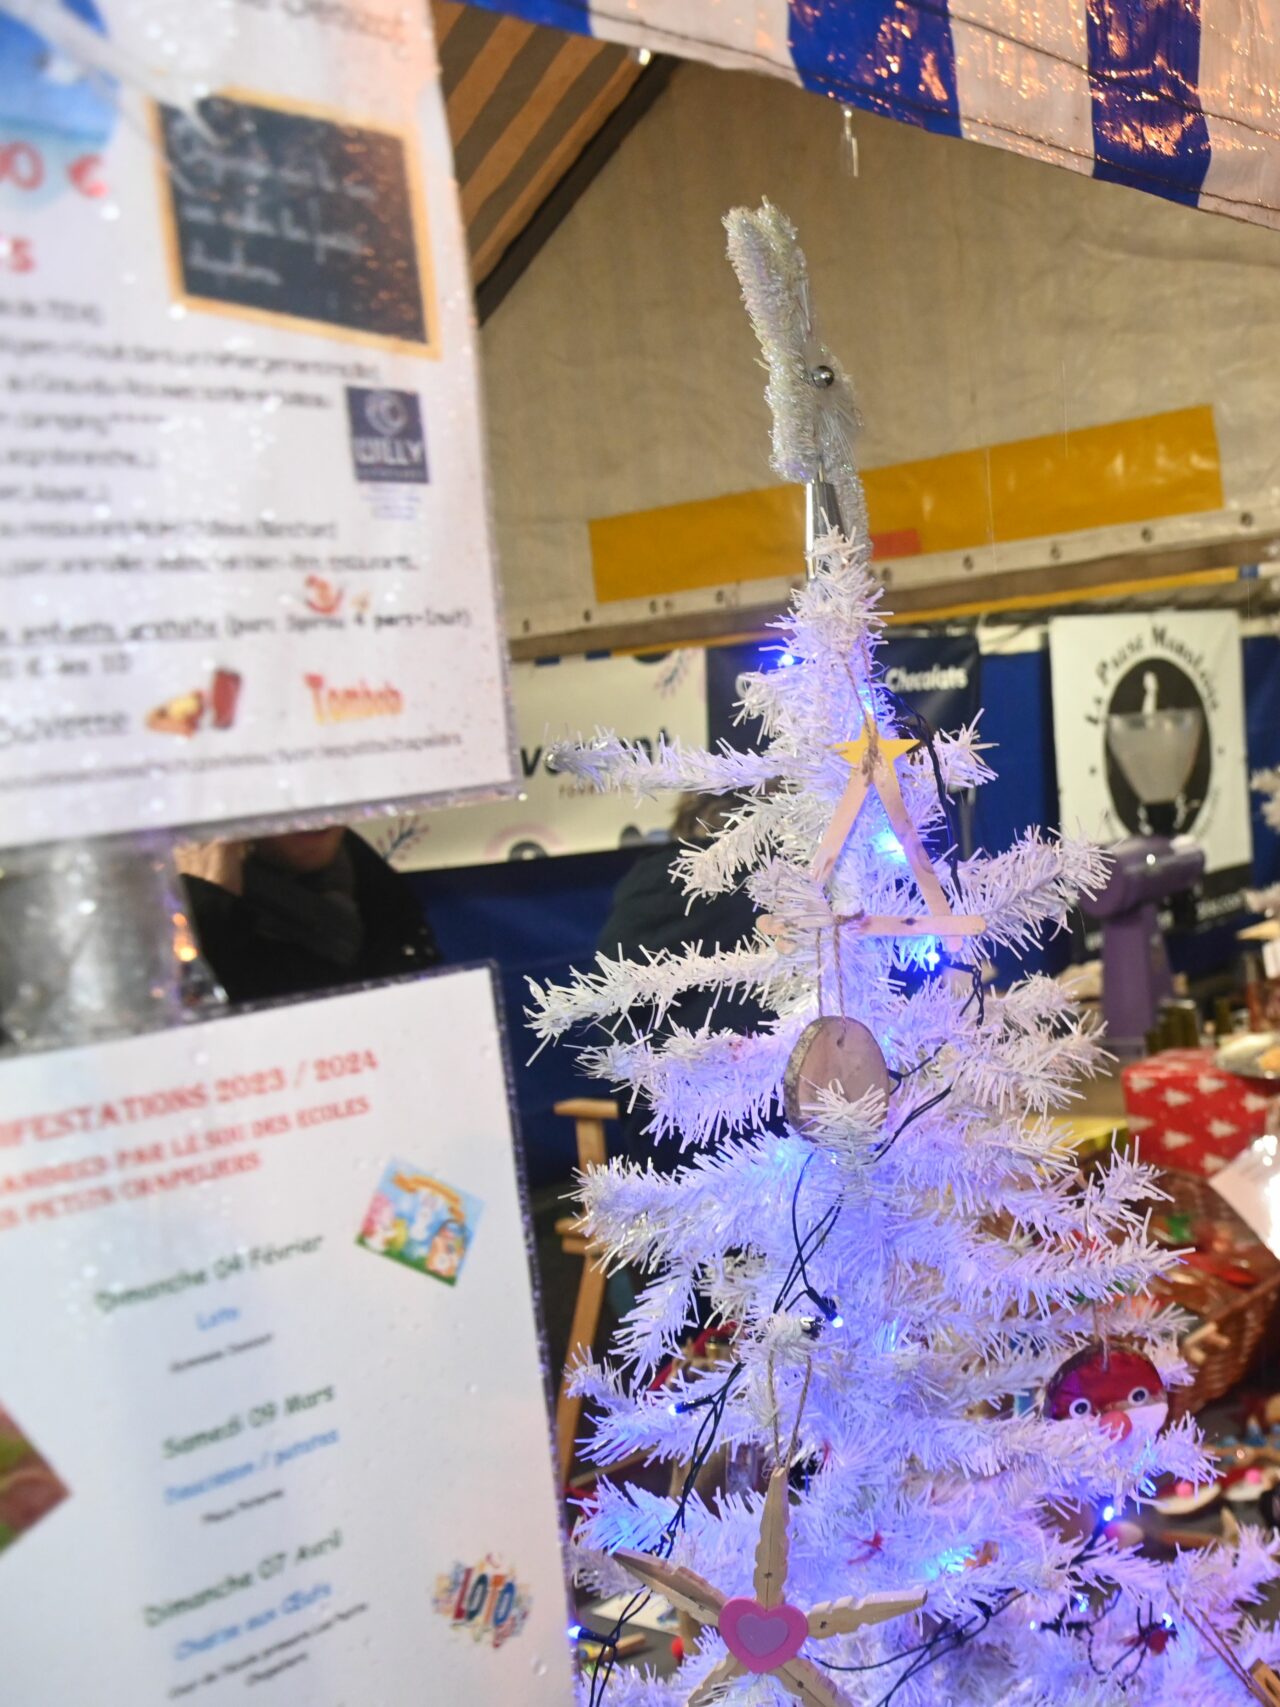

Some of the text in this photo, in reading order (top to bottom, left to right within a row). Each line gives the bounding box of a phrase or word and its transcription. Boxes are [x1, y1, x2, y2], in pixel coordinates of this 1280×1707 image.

[887, 665, 967, 692] Chocolats
[217, 1068, 285, 1101] 2023
[314, 1050, 377, 1081] 2024
[117, 1144, 163, 1168] PAR
[171, 1135, 200, 1158] LE
[254, 1115, 290, 1138] DES
[299, 1097, 370, 1128] ECOLES
[163, 1386, 335, 1458] Samedi 09 Mars
[145, 1529, 342, 1626] Dimanche 07 Avril
[454, 1568, 514, 1626] LOTO
